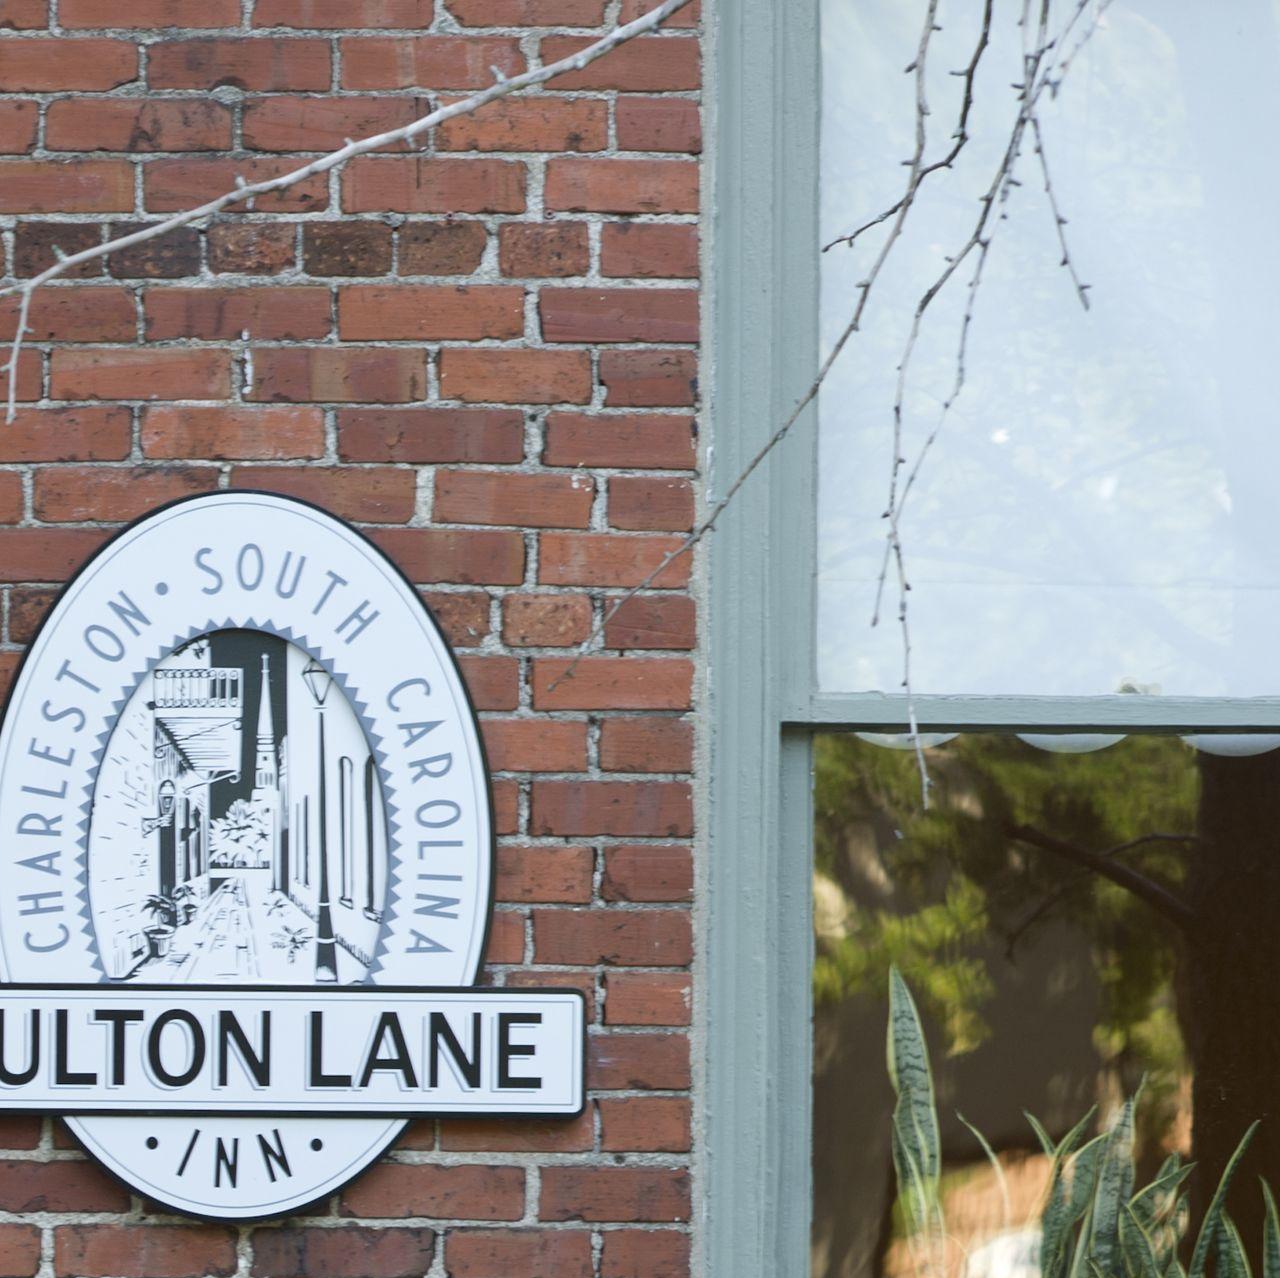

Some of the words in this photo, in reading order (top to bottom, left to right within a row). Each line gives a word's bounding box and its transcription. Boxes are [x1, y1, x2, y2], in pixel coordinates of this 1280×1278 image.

[16, 590, 152, 954] CHARLESTON
[193, 543, 380, 645] SOUTH
[385, 677, 465, 955] CAROLINA
[309, 1010, 543, 1090] LANE
[176, 1128, 292, 1189] INN
